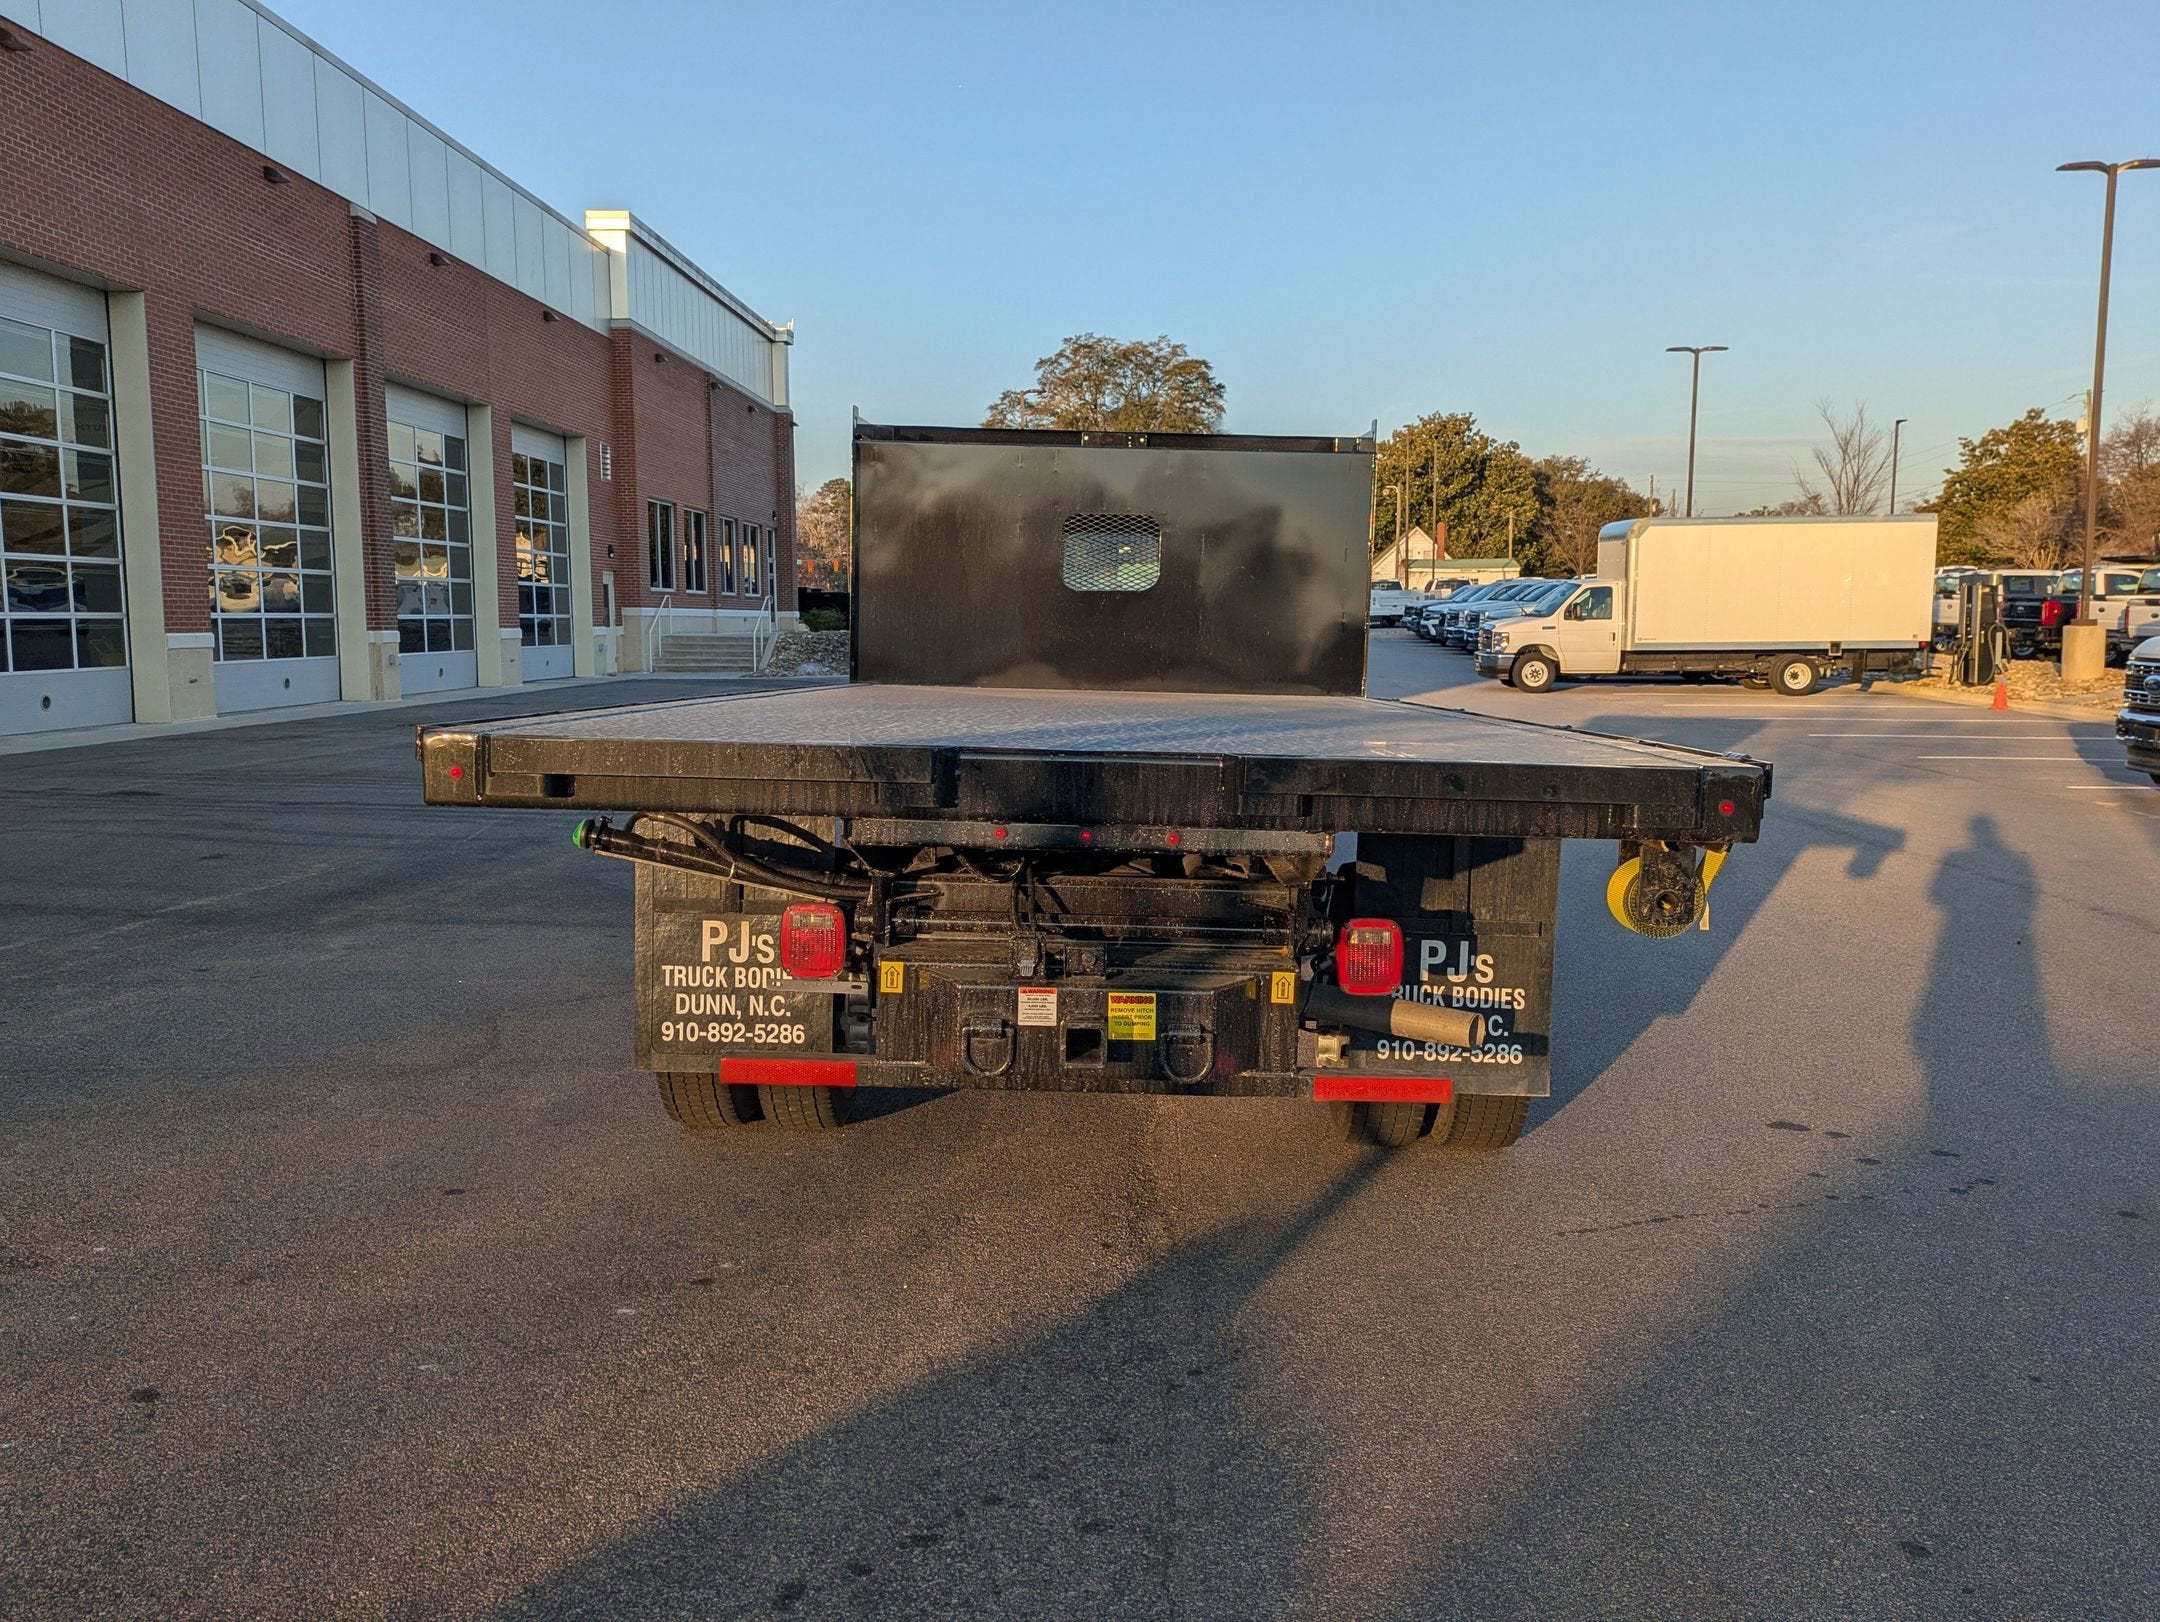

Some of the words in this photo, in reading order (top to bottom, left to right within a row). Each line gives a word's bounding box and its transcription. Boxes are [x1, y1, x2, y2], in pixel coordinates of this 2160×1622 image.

[661, 965, 728, 988] TRUCK
[675, 993, 742, 1020] DUNN,
[749, 994, 792, 1017] N.C.
[1110, 995, 1155, 1005] WARNING
[1391, 984, 1446, 1007] RUCK
[1452, 986, 1526, 1010] BODIES
[661, 1021, 806, 1044] 910-892-5286
[1376, 1039, 1523, 1065] 910-892-5286
